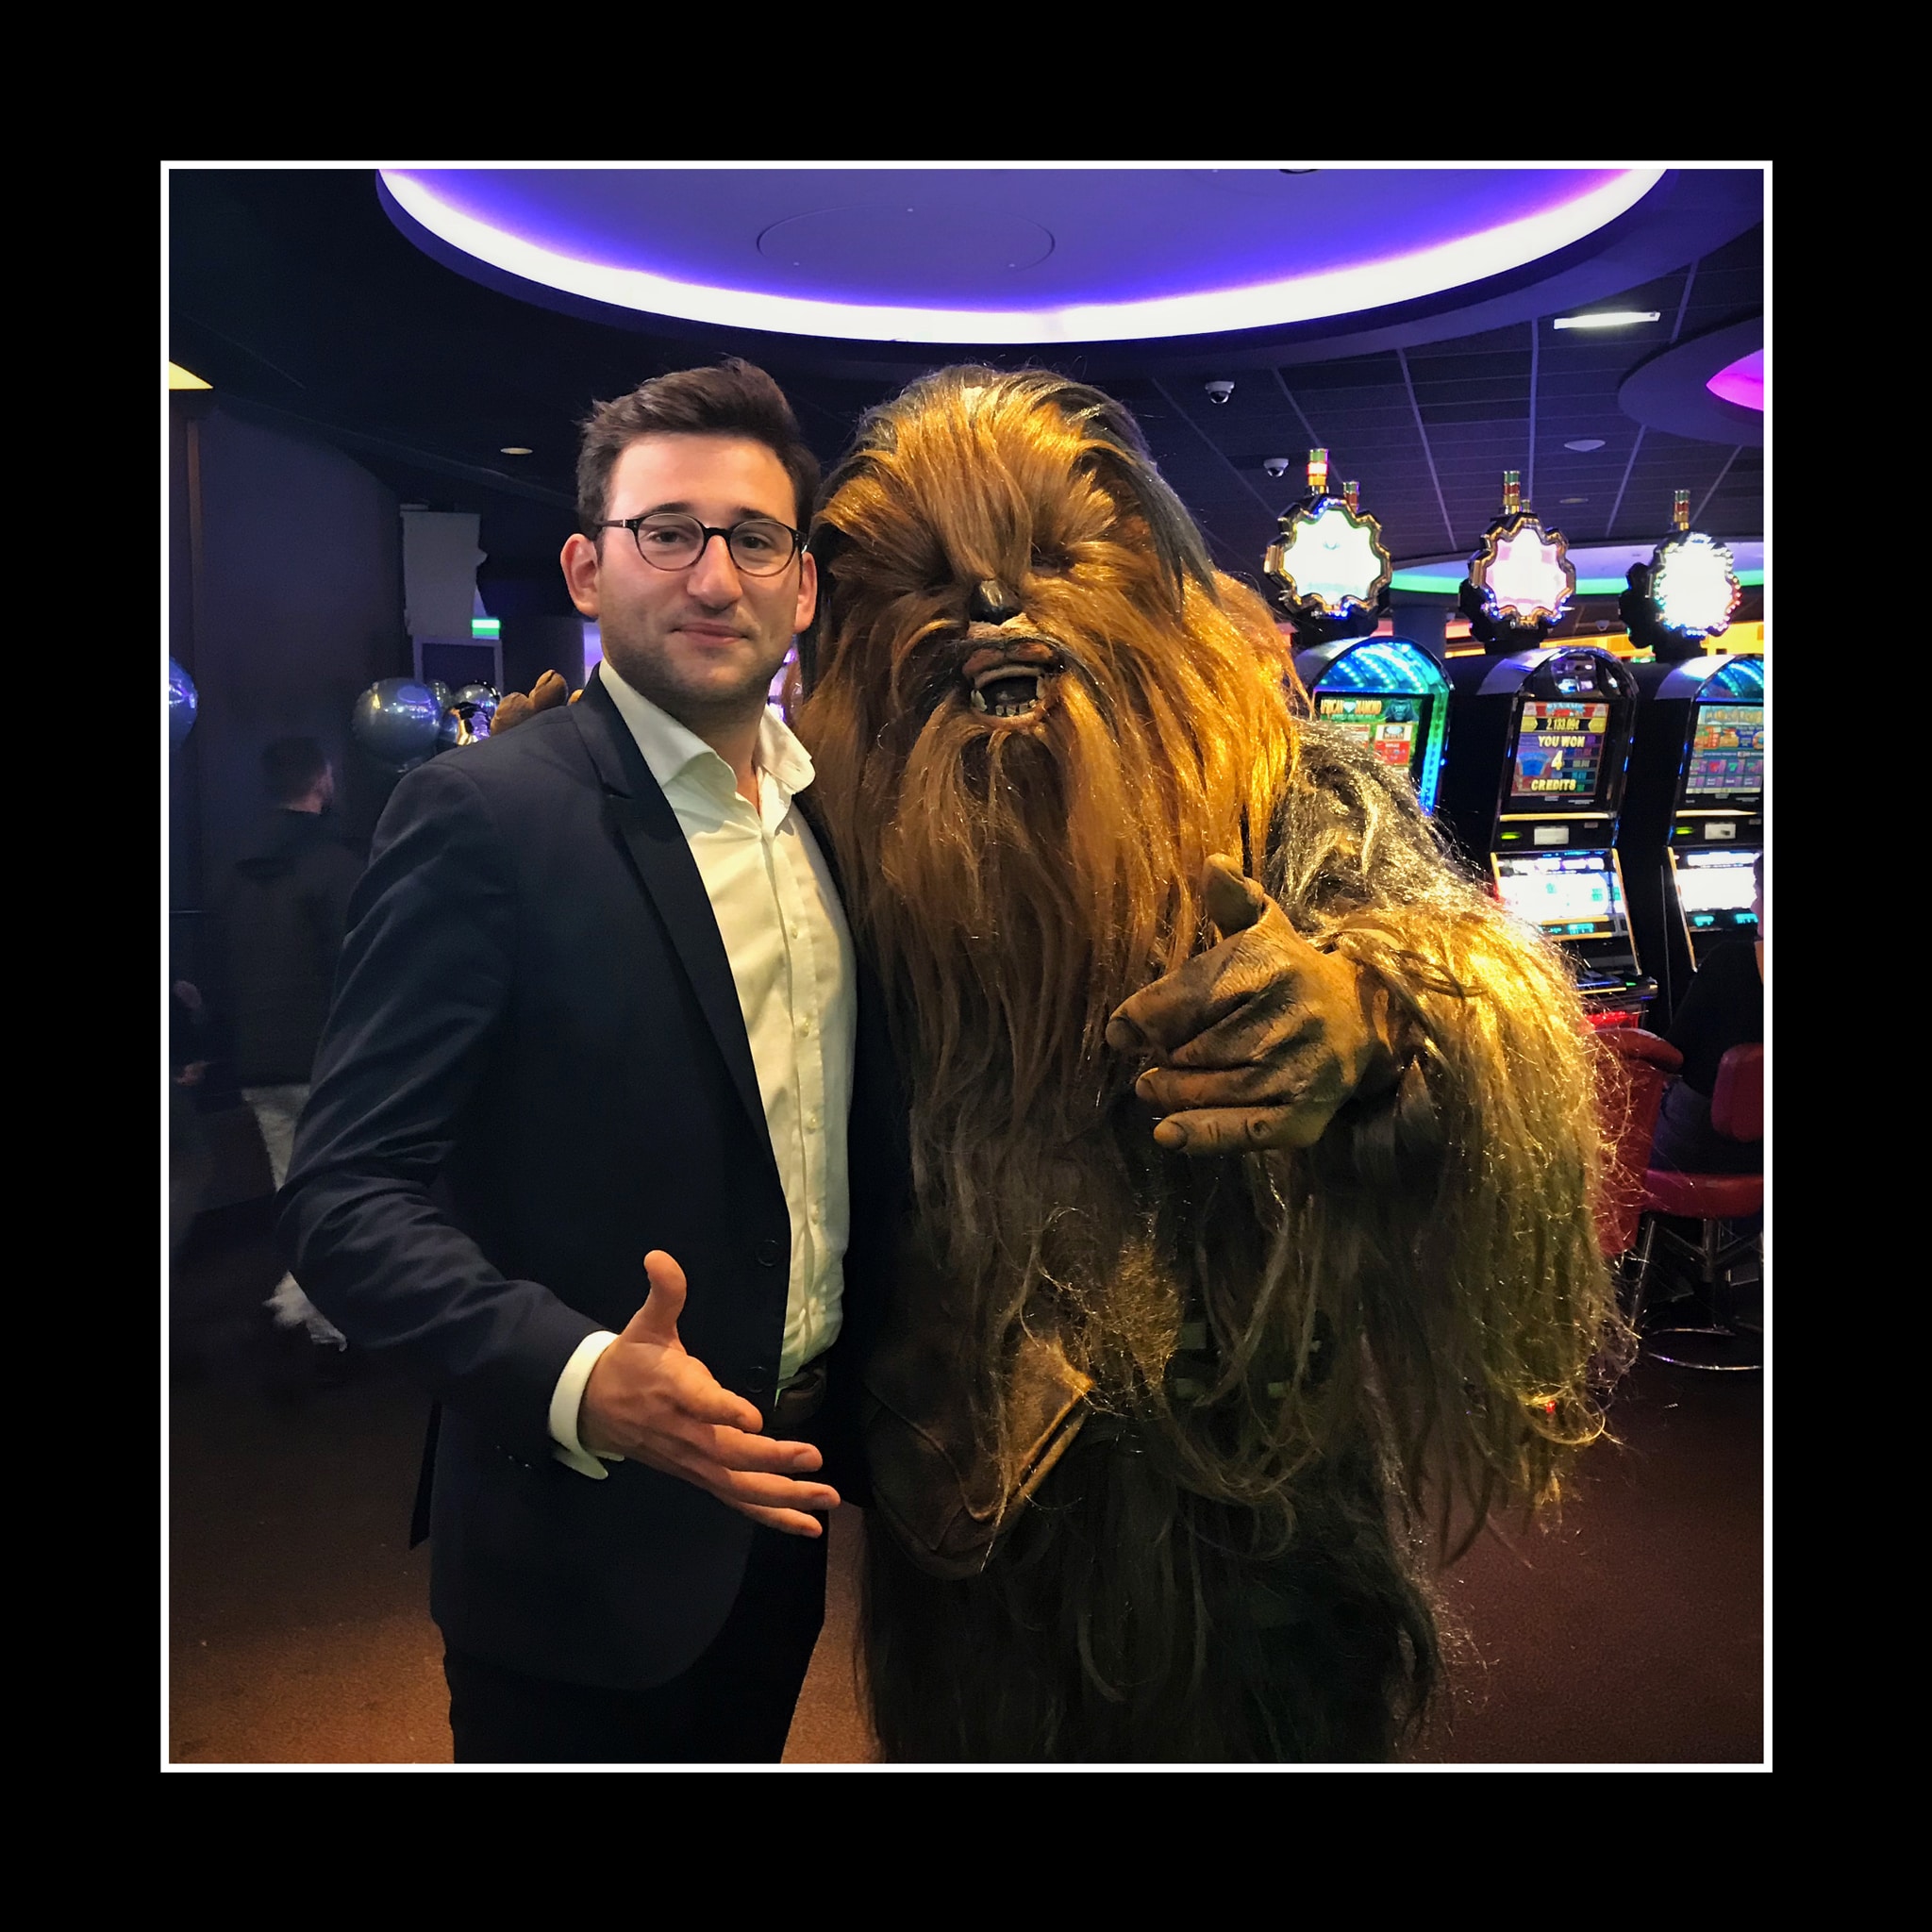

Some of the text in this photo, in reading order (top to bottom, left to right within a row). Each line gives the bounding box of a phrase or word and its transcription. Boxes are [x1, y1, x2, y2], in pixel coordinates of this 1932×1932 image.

[1538, 736, 1585, 747] YOU WON
[1551, 750, 1564, 771] 4
[1531, 779, 1576, 791] CREDITS
